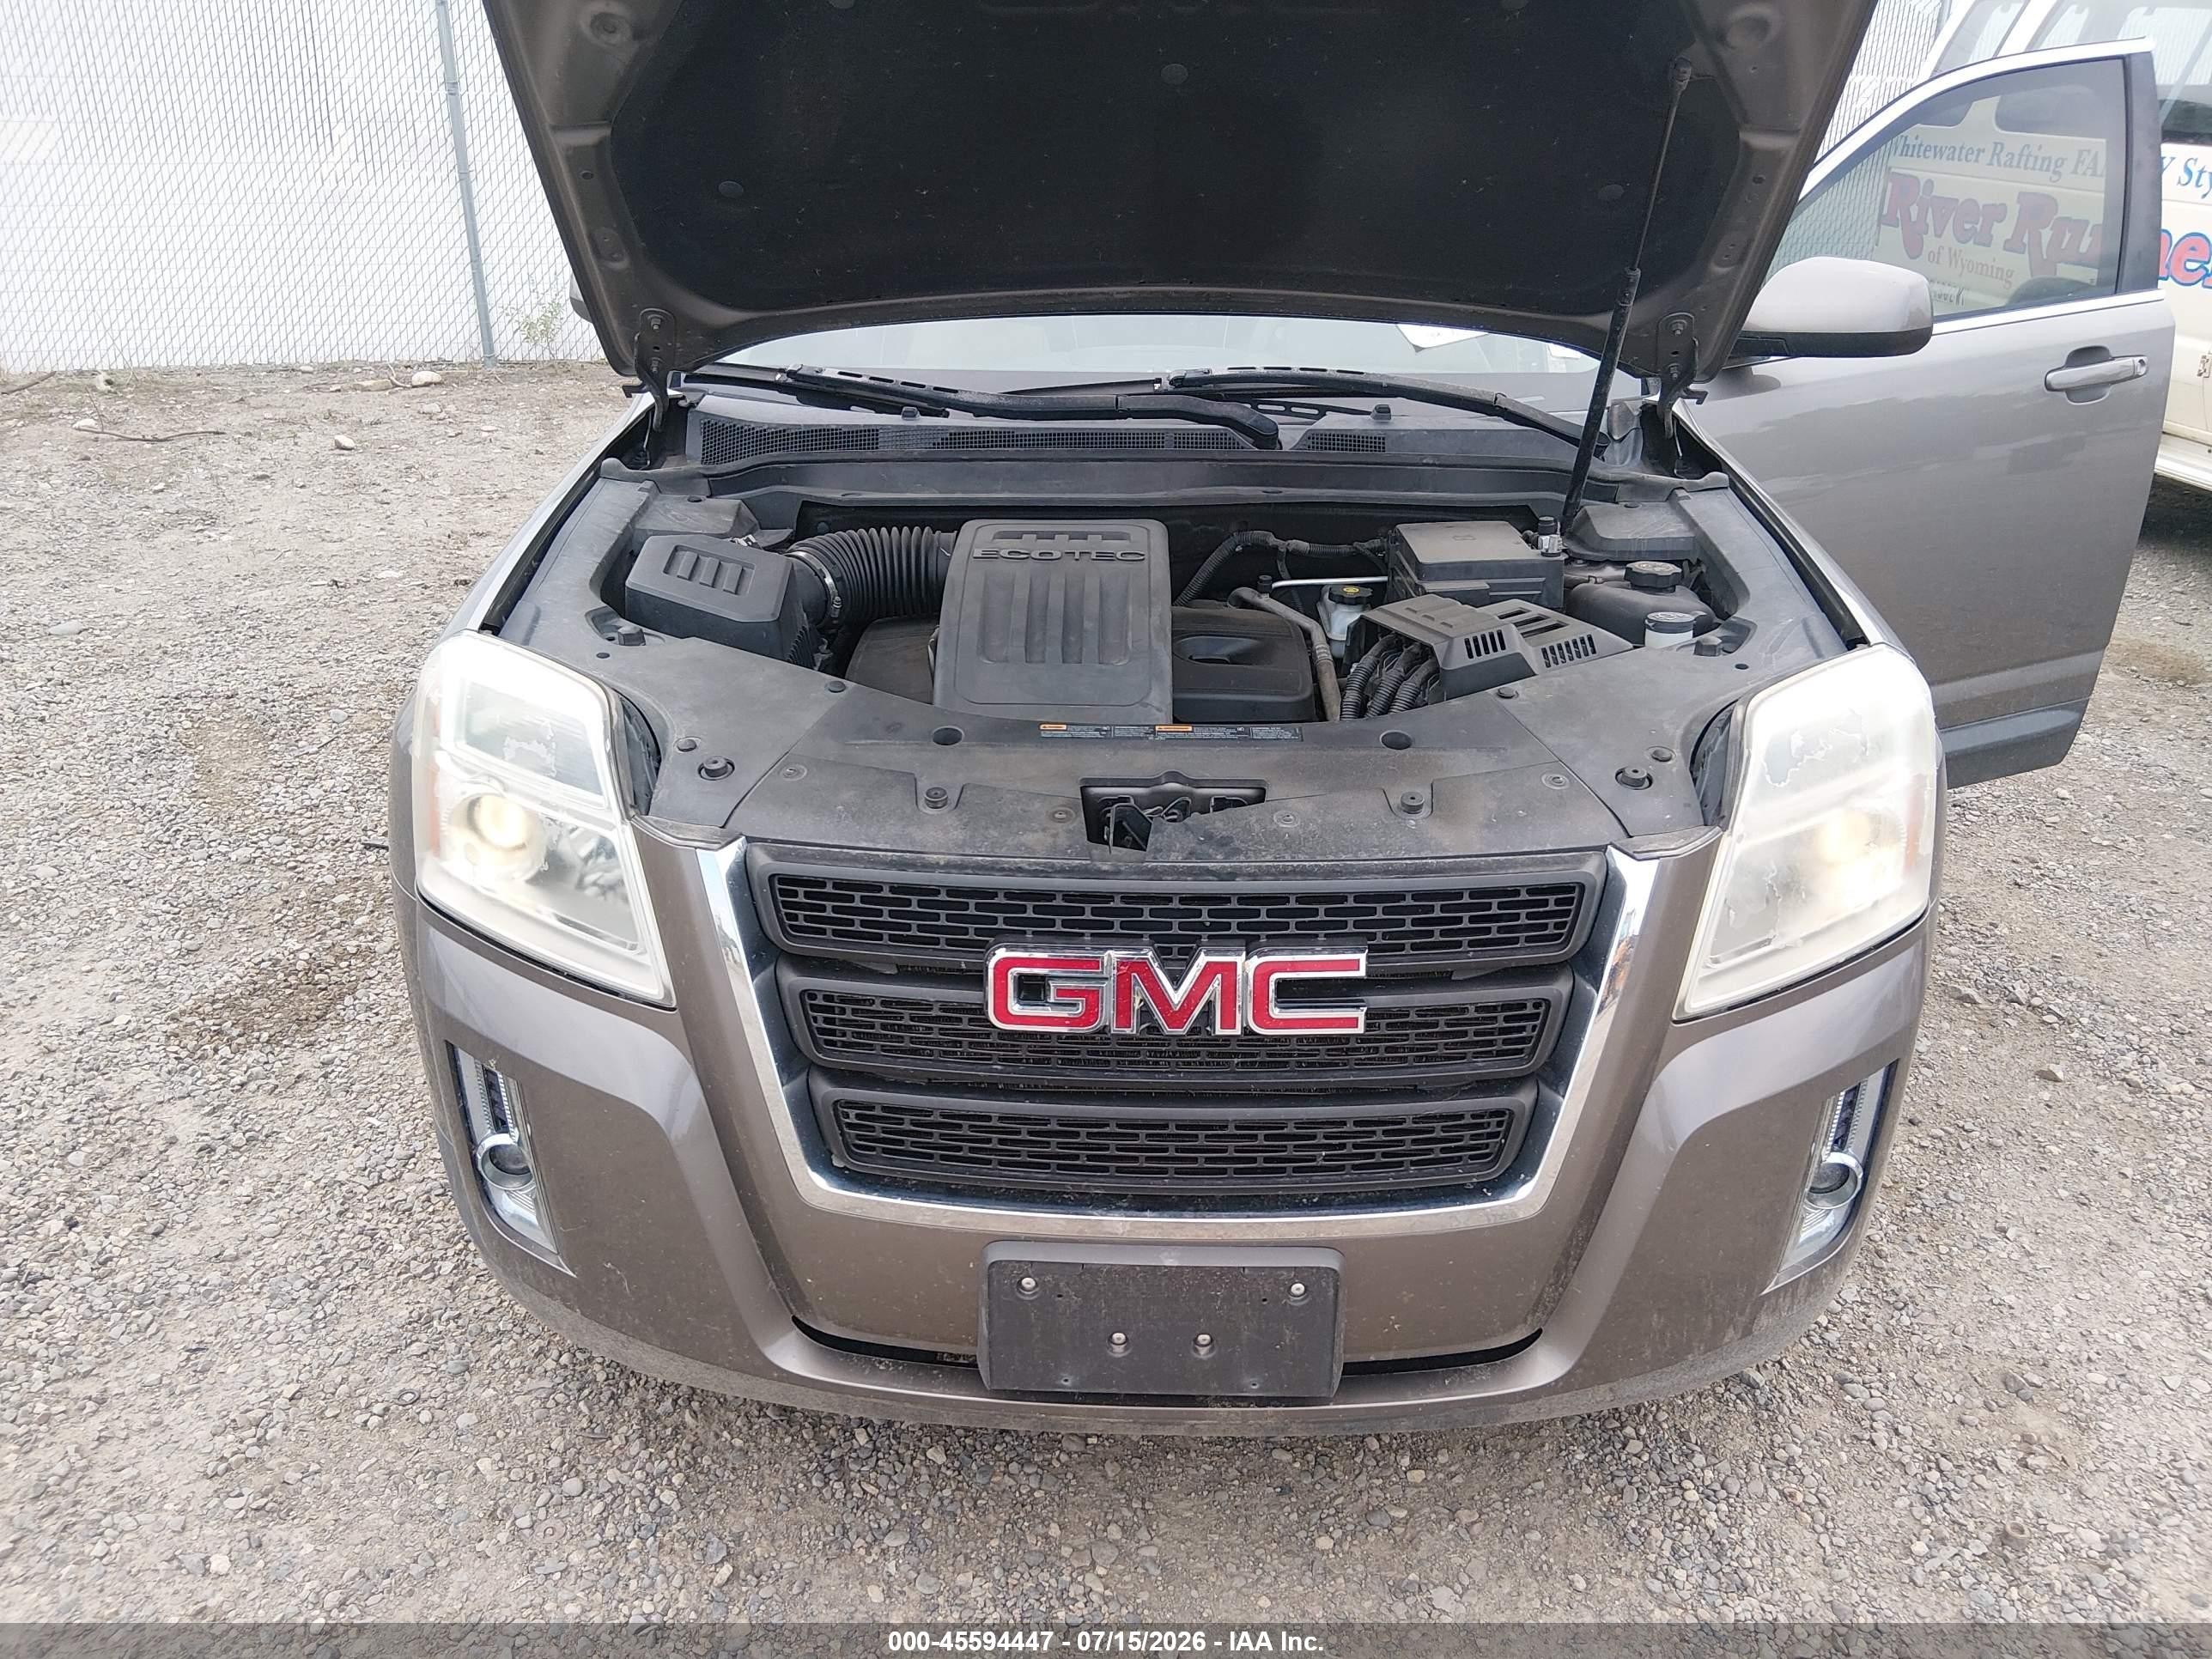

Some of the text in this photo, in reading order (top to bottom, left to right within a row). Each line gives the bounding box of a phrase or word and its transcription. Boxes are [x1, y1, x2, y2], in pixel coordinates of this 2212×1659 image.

[1892, 134, 1986, 163] Whitewater
[1986, 141, 2068, 183] Rafting
[2069, 149, 2106, 178] FA
[1881, 172, 2008, 259] River
[1927, 246, 2016, 290] of Wyoming
[973, 548, 1146, 562] ECOTEC
[987, 945, 1368, 1036] GMC
